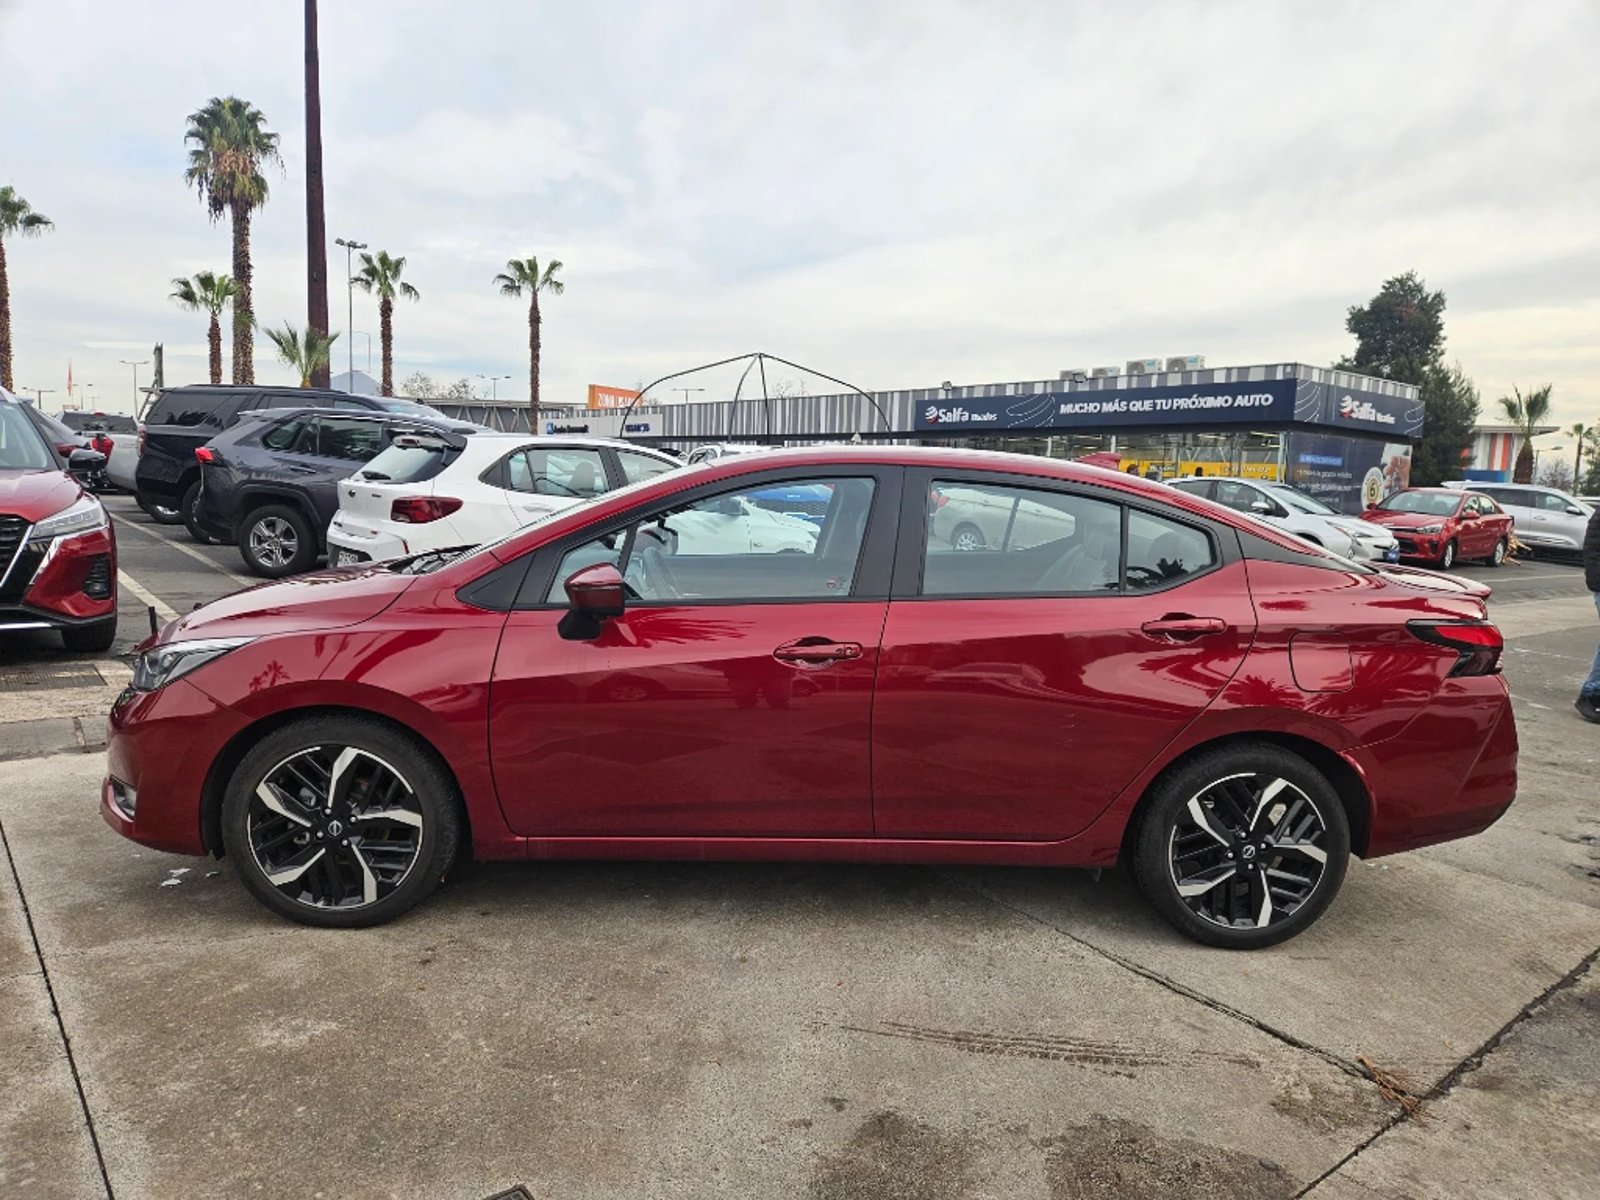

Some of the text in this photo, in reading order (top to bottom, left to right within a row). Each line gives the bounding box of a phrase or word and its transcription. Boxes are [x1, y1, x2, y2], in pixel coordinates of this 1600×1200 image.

[1059, 394, 1274, 414] MUCHO MÁS QUE TU PRÓXIMO AUTO
[938, 407, 969, 423] Salfa
